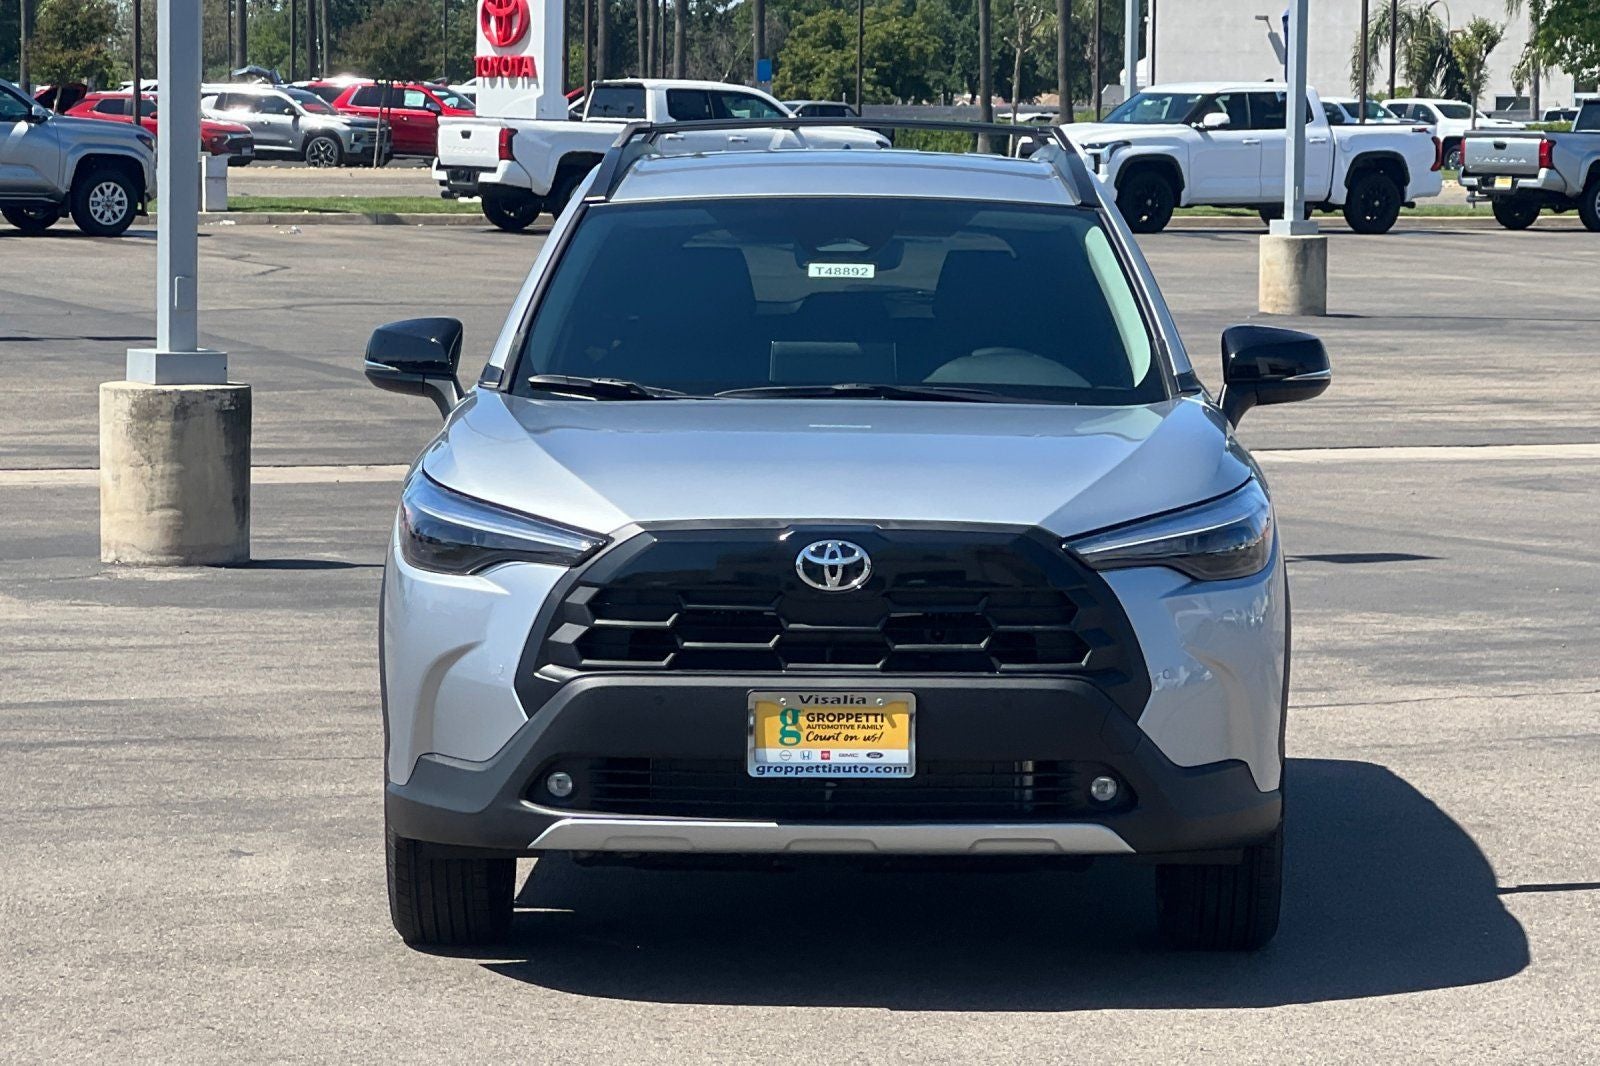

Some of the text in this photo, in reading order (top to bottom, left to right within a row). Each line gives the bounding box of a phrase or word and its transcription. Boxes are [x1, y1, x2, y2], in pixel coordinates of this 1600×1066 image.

[474, 55, 537, 77] TOYOTA
[815, 266, 869, 276] T48892
[798, 694, 867, 705] Visalia
[806, 712, 885, 723] GROPPETTI
[806, 731, 884, 743] Count on us!
[756, 764, 908, 775] groppettiauto.com
